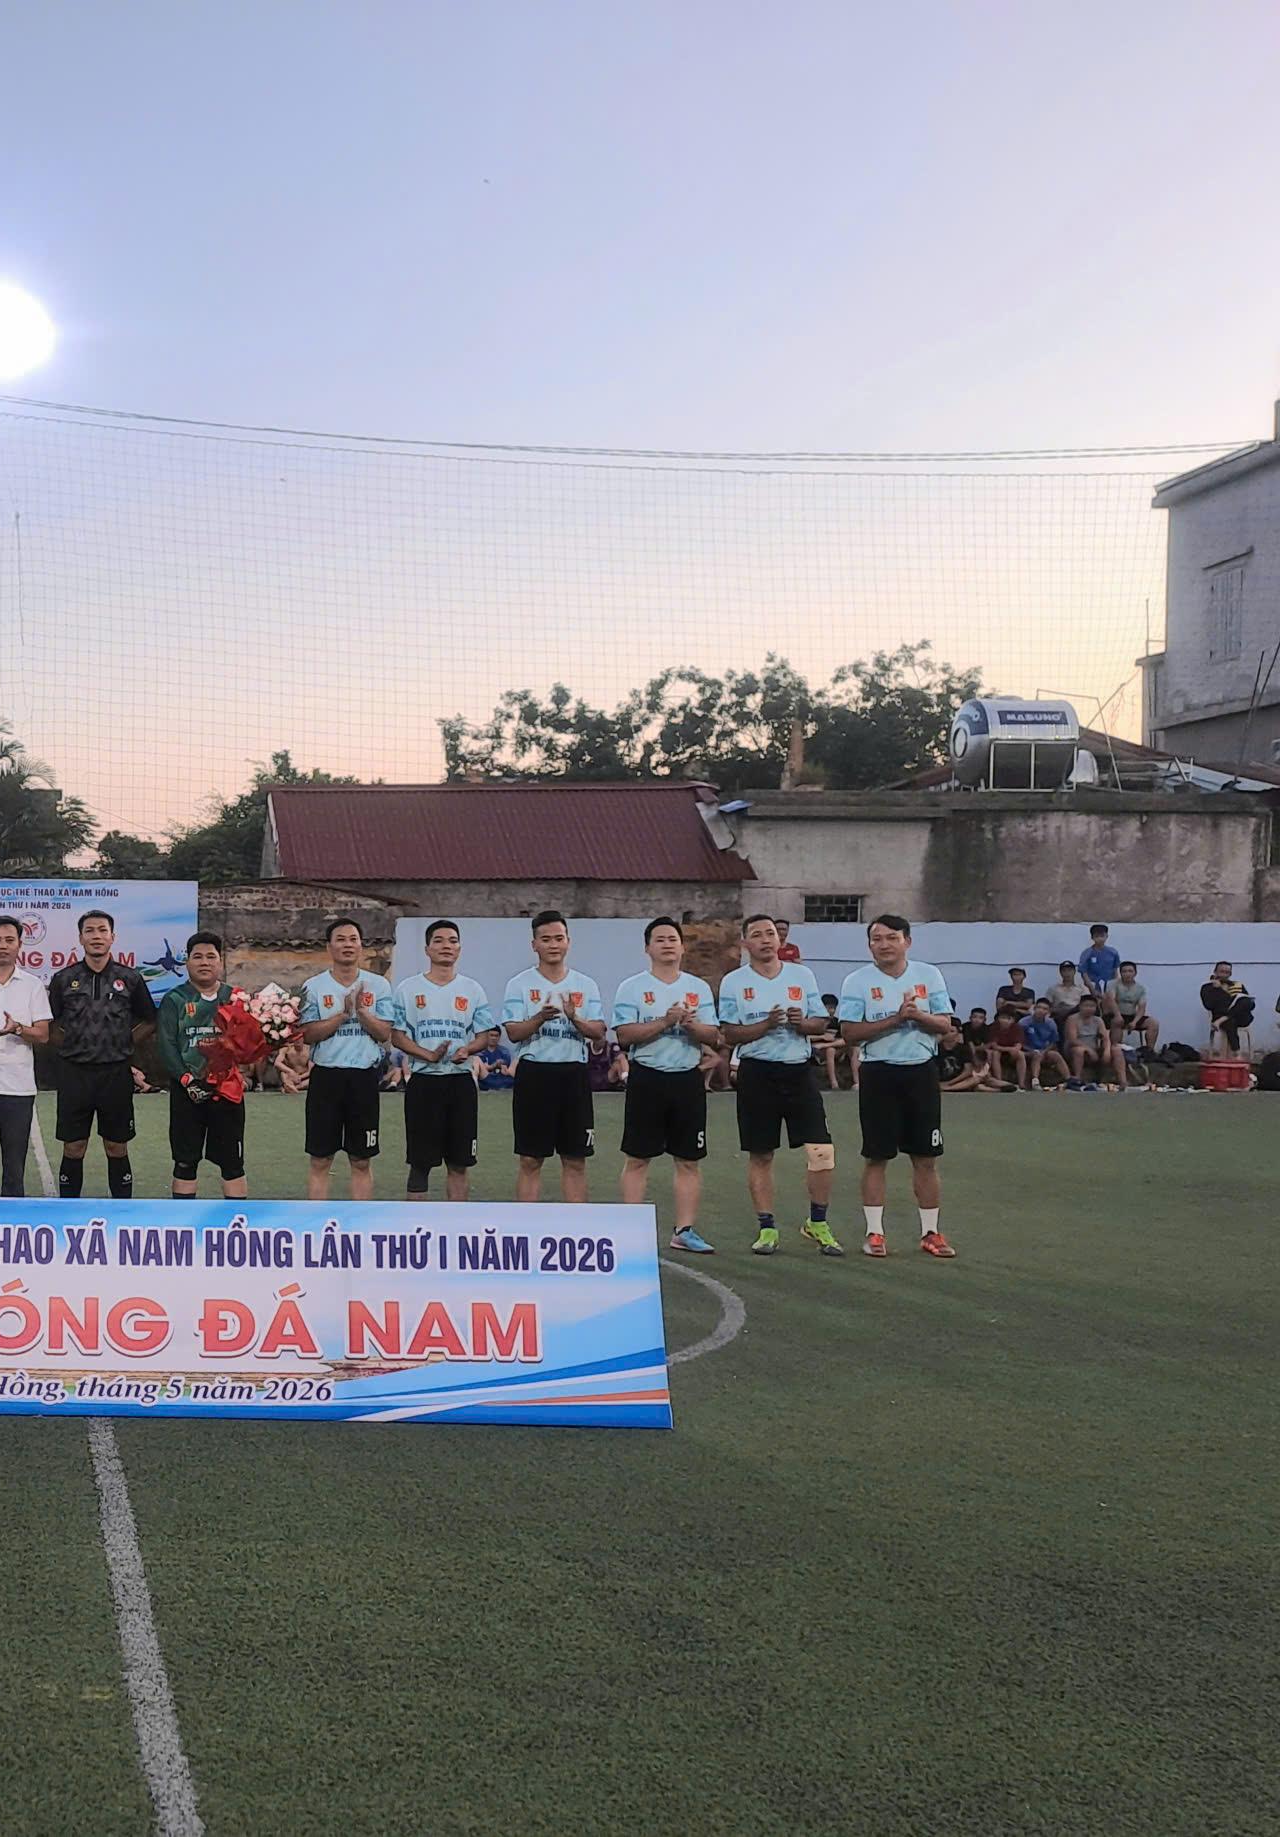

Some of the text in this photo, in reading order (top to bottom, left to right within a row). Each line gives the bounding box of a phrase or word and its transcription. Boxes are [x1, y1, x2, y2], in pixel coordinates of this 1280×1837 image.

[71, 888, 93, 897] NAM
[366, 1130, 377, 1148] 16
[65, 1219, 106, 1266] XÃ
[119, 1228, 193, 1267] NAM
[204, 1215, 293, 1269] HỒNG
[304, 1220, 362, 1269] LẦN
[371, 1227, 432, 1270] THỨ
[438, 1234, 448, 1270] I
[458, 1228, 530, 1272] NĂM
[539, 1236, 615, 1274] 2026
[198, 1282, 320, 1355] ĐÁ
[348, 1300, 540, 1359] NAM
[77, 1377, 159, 1403] tháng
[168, 1380, 182, 1399] 5
[191, 1377, 256, 1400] năm
[263, 1380, 332, 1401] 2026
